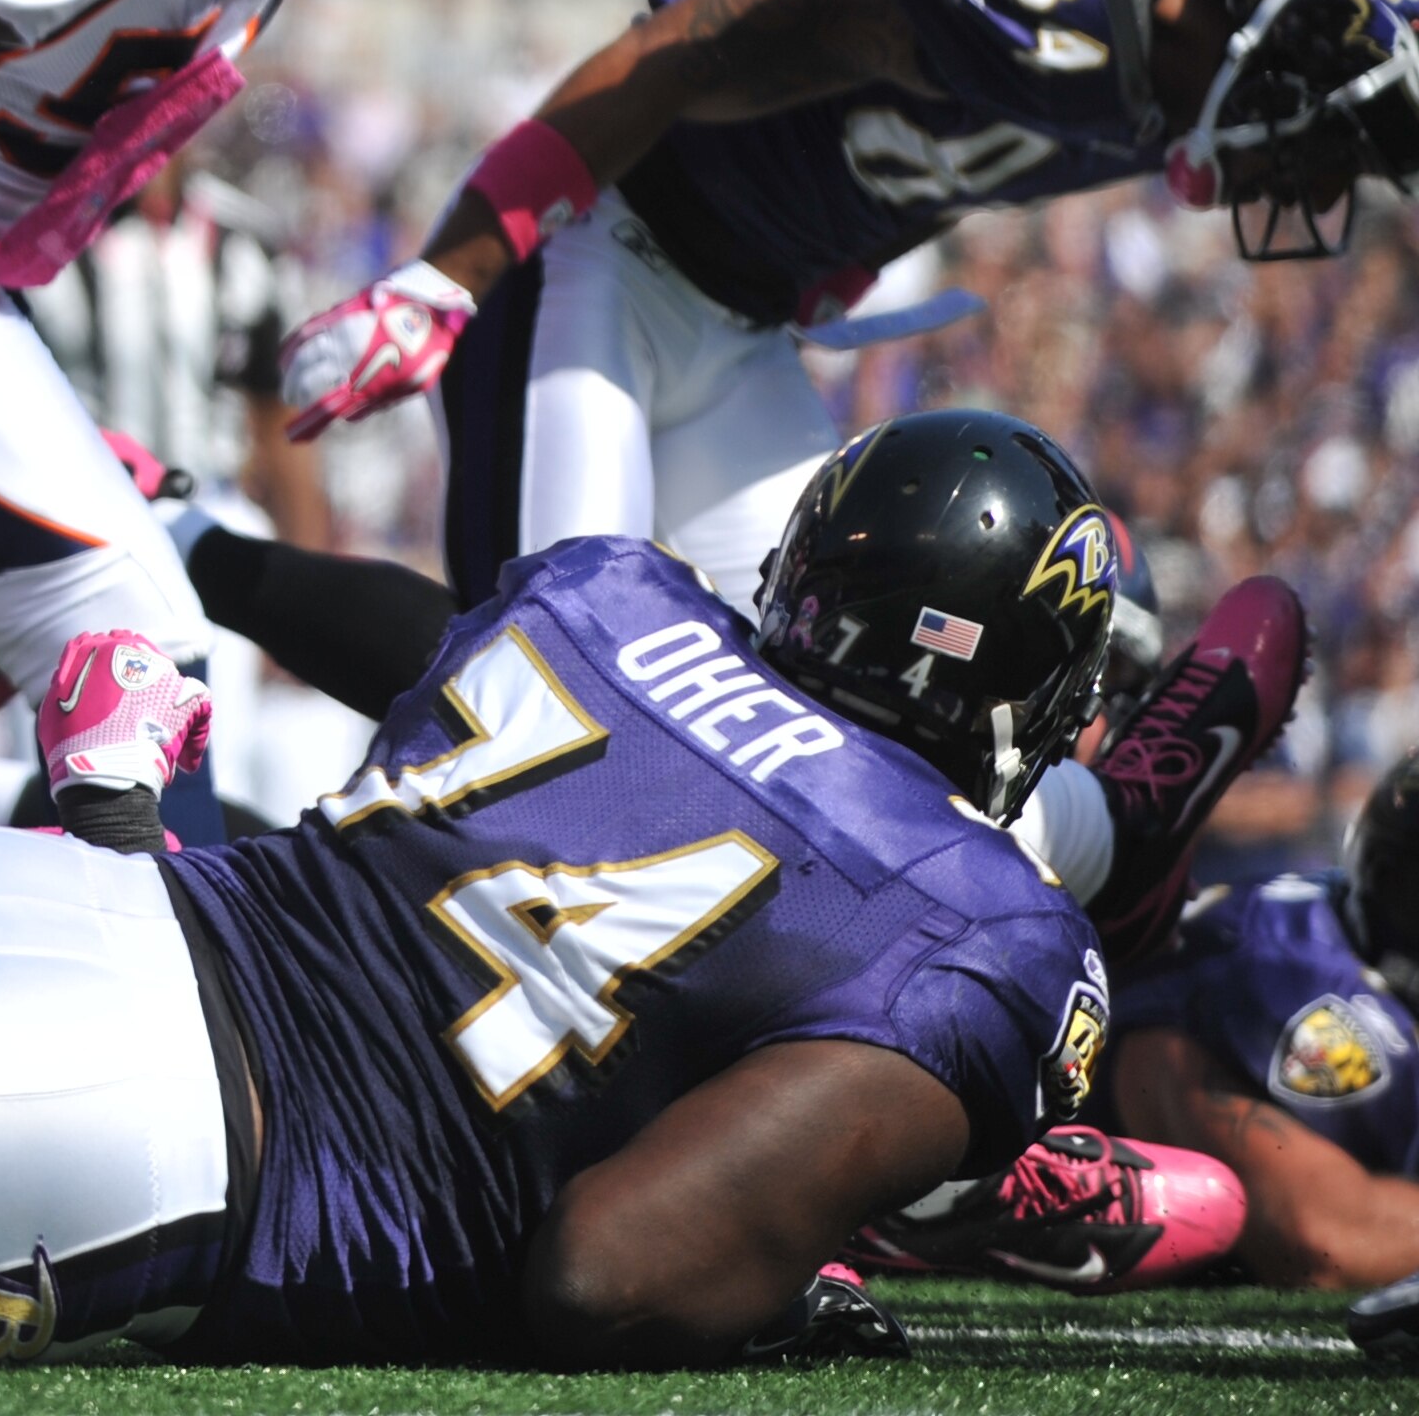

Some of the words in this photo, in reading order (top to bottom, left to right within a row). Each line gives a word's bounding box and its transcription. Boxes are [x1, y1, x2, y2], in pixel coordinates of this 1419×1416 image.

[1063, 516, 1110, 585] B
[616, 619, 846, 784] OHER
[317, 623, 781, 1114] 74
